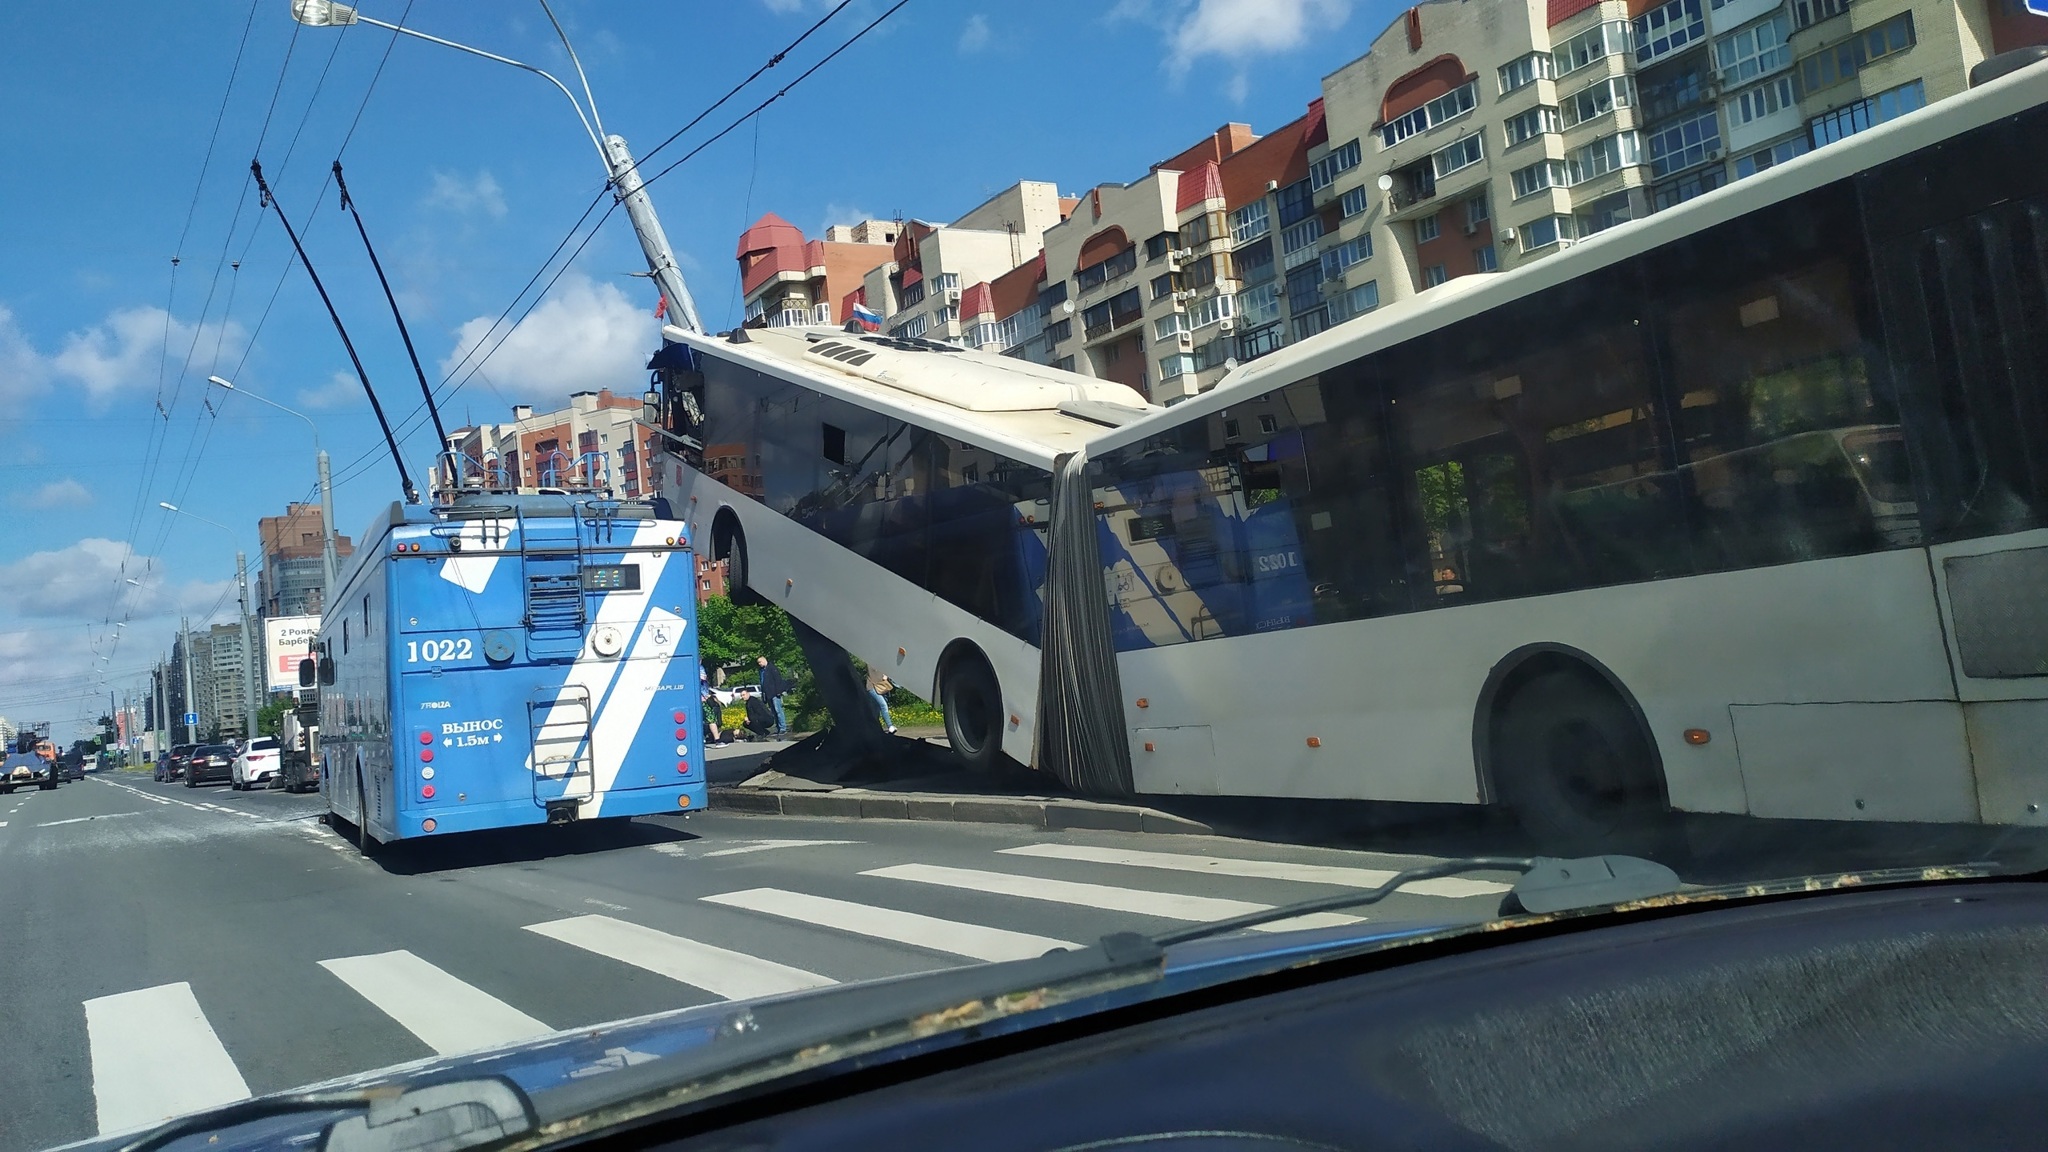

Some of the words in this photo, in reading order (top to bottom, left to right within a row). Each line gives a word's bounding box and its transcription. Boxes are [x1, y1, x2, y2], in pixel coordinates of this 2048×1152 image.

[280, 629, 287, 637] 2
[289, 628, 318, 636] Роял
[279, 637, 309, 647] Барбе
[407, 639, 473, 662] 1022
[442, 719, 503, 734] ВЫНОС
